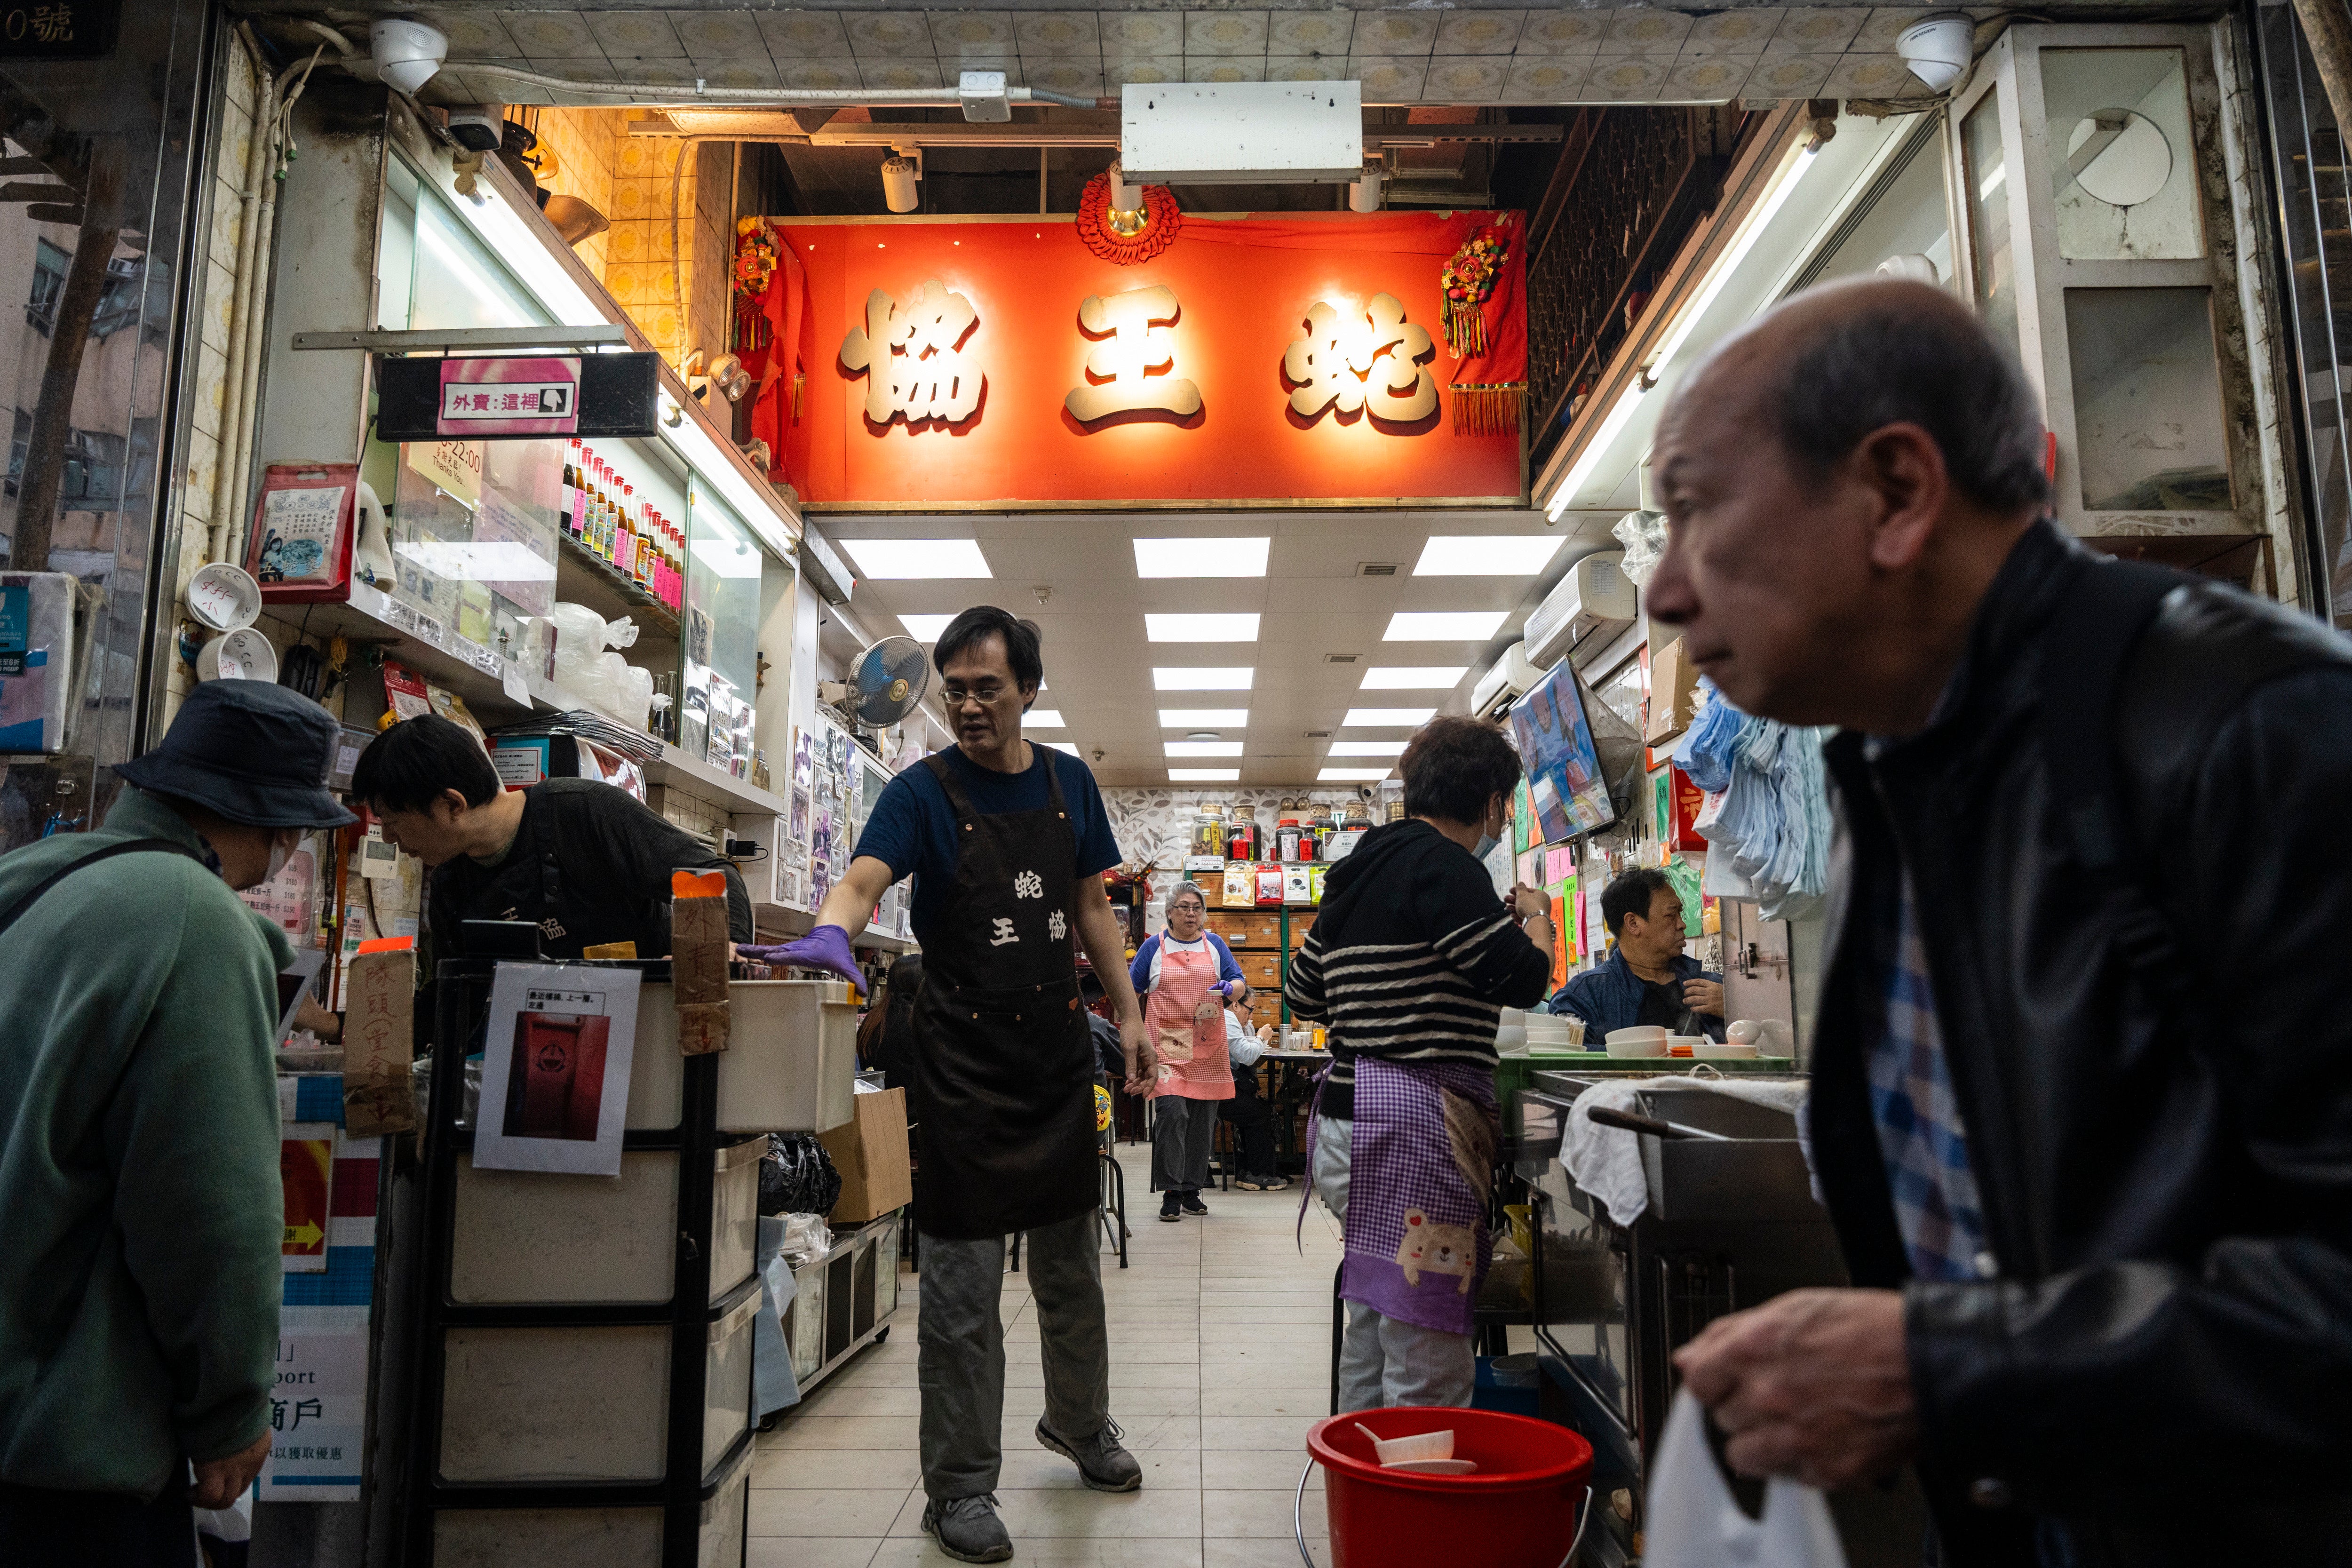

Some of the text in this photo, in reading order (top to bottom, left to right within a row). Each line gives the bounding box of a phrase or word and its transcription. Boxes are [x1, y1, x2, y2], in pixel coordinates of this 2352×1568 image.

[1910, 27, 1936, 41] HIKVISION
[433, 455, 452, 478] Thanks
[1015, 870, 1043, 899] 蛇
[990, 917, 1020, 947] 王
